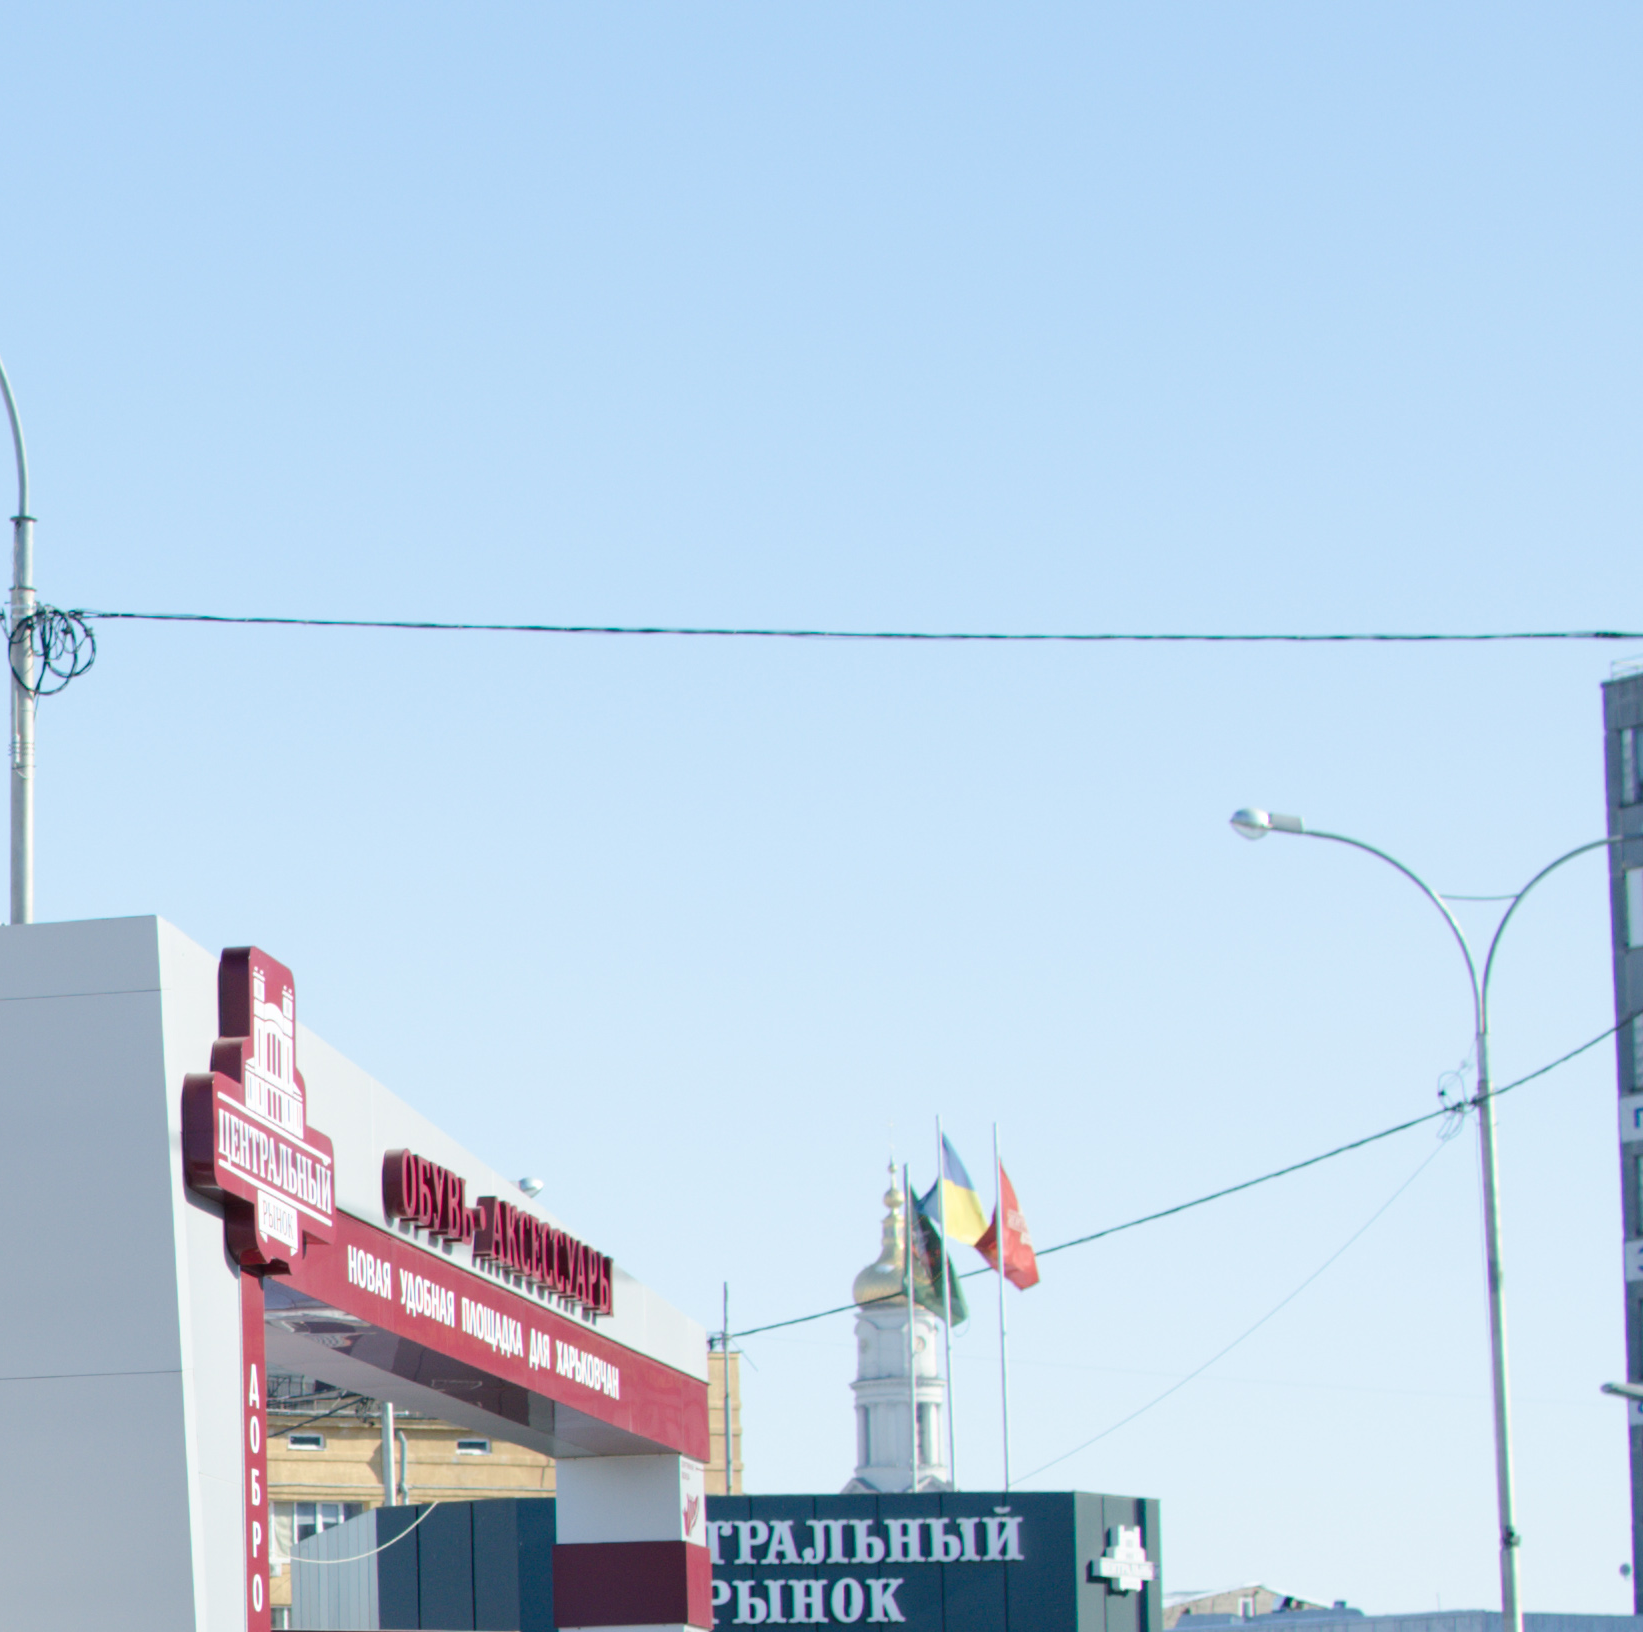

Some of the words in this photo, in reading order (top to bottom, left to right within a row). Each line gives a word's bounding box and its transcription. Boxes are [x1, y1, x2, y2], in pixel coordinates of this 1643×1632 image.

[218, 1108, 332, 1214] ЦЕНТРАЛЬНЫЙ
[262, 1199, 294, 1239] РЫНОК
[388, 1149, 473, 1246] ОБУВЬ
[477, 1197, 614, 1317] АКСЕССУАРЫ
[347, 1245, 391, 1300] НОВАЯ
[399, 1268, 454, 1327] УДОБНАЯ
[461, 1298, 523, 1358] ПЛОЩАДКА
[529, 1329, 550, 1370] ДЛЯ
[556, 1340, 619, 1400] ХАРЬКОВЧАН
[249, 1364, 264, 1613] ДОБРО
[711, 1578, 906, 1625] РЫНОК
